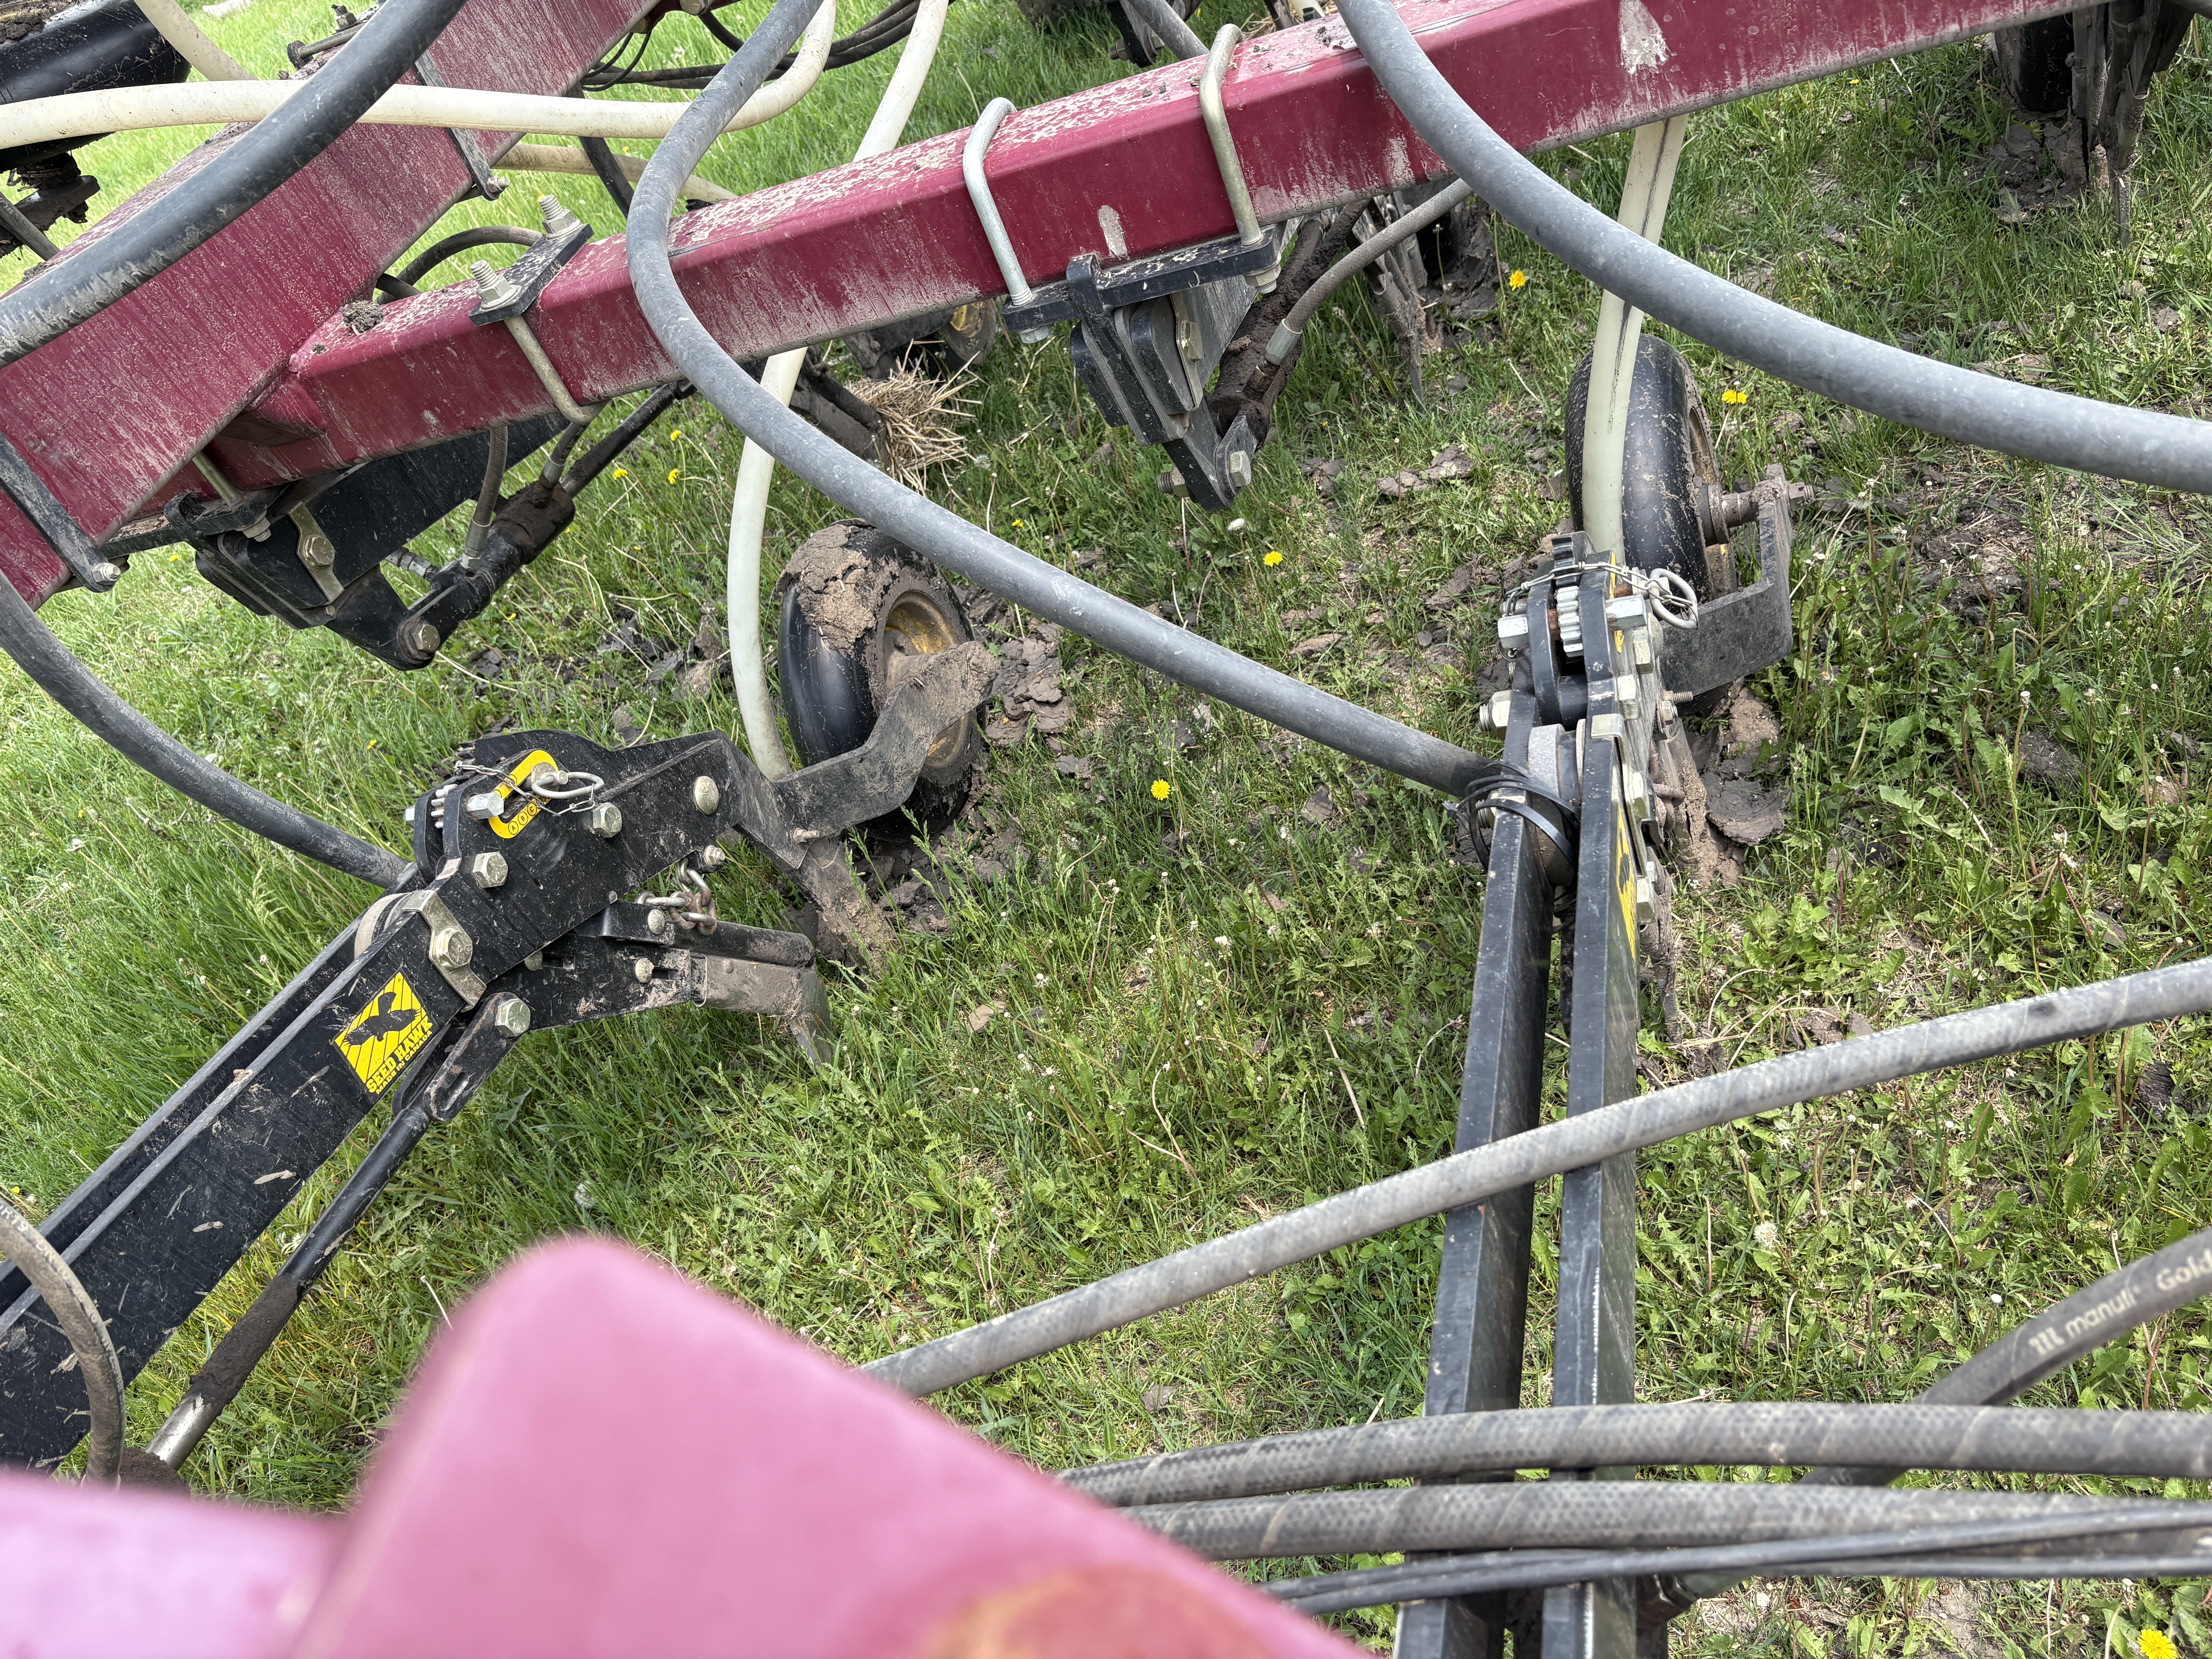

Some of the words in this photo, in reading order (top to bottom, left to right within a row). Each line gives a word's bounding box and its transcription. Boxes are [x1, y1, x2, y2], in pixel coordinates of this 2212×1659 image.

[366, 1057, 396, 1093] SEED
[394, 1015, 433, 1061] HAWK
[376, 1070, 397, 1095] MADE
[396, 1061, 405, 1071] IN
[405, 1030, 433, 1061] CANADA
